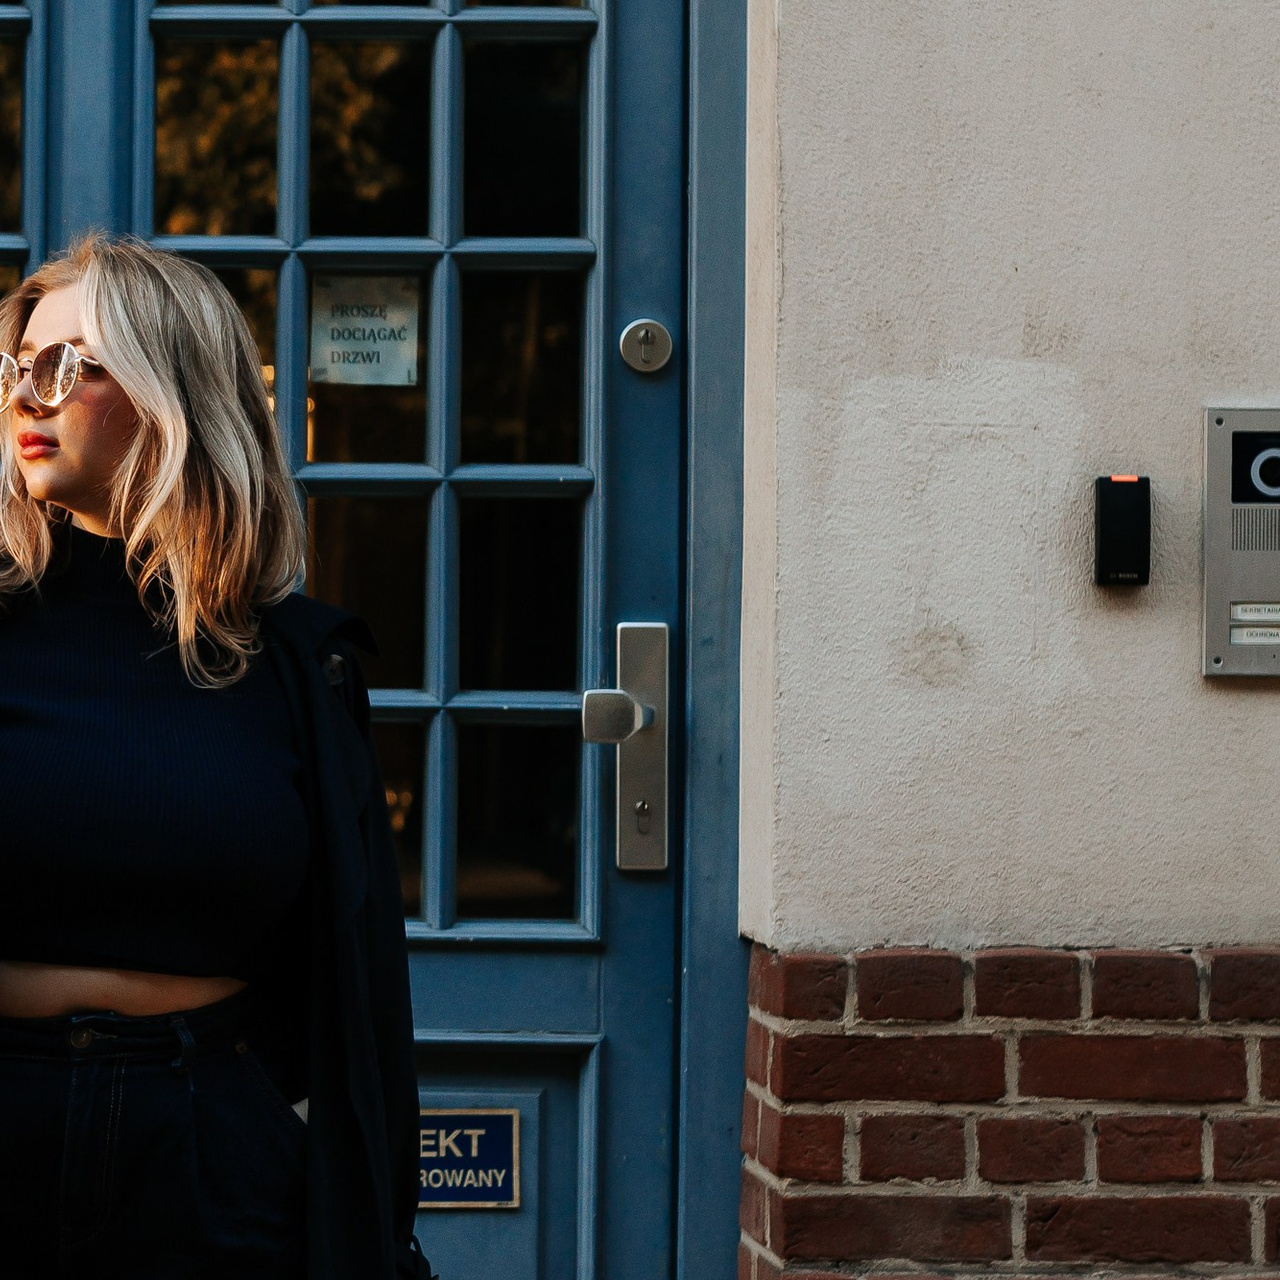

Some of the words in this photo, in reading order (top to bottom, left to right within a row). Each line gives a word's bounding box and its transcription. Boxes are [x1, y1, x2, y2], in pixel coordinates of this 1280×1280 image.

[331, 304, 388, 320] PROSZĘ
[330, 326, 408, 343] DOCIĄGAĆ
[330, 351, 381, 364] DRZWI
